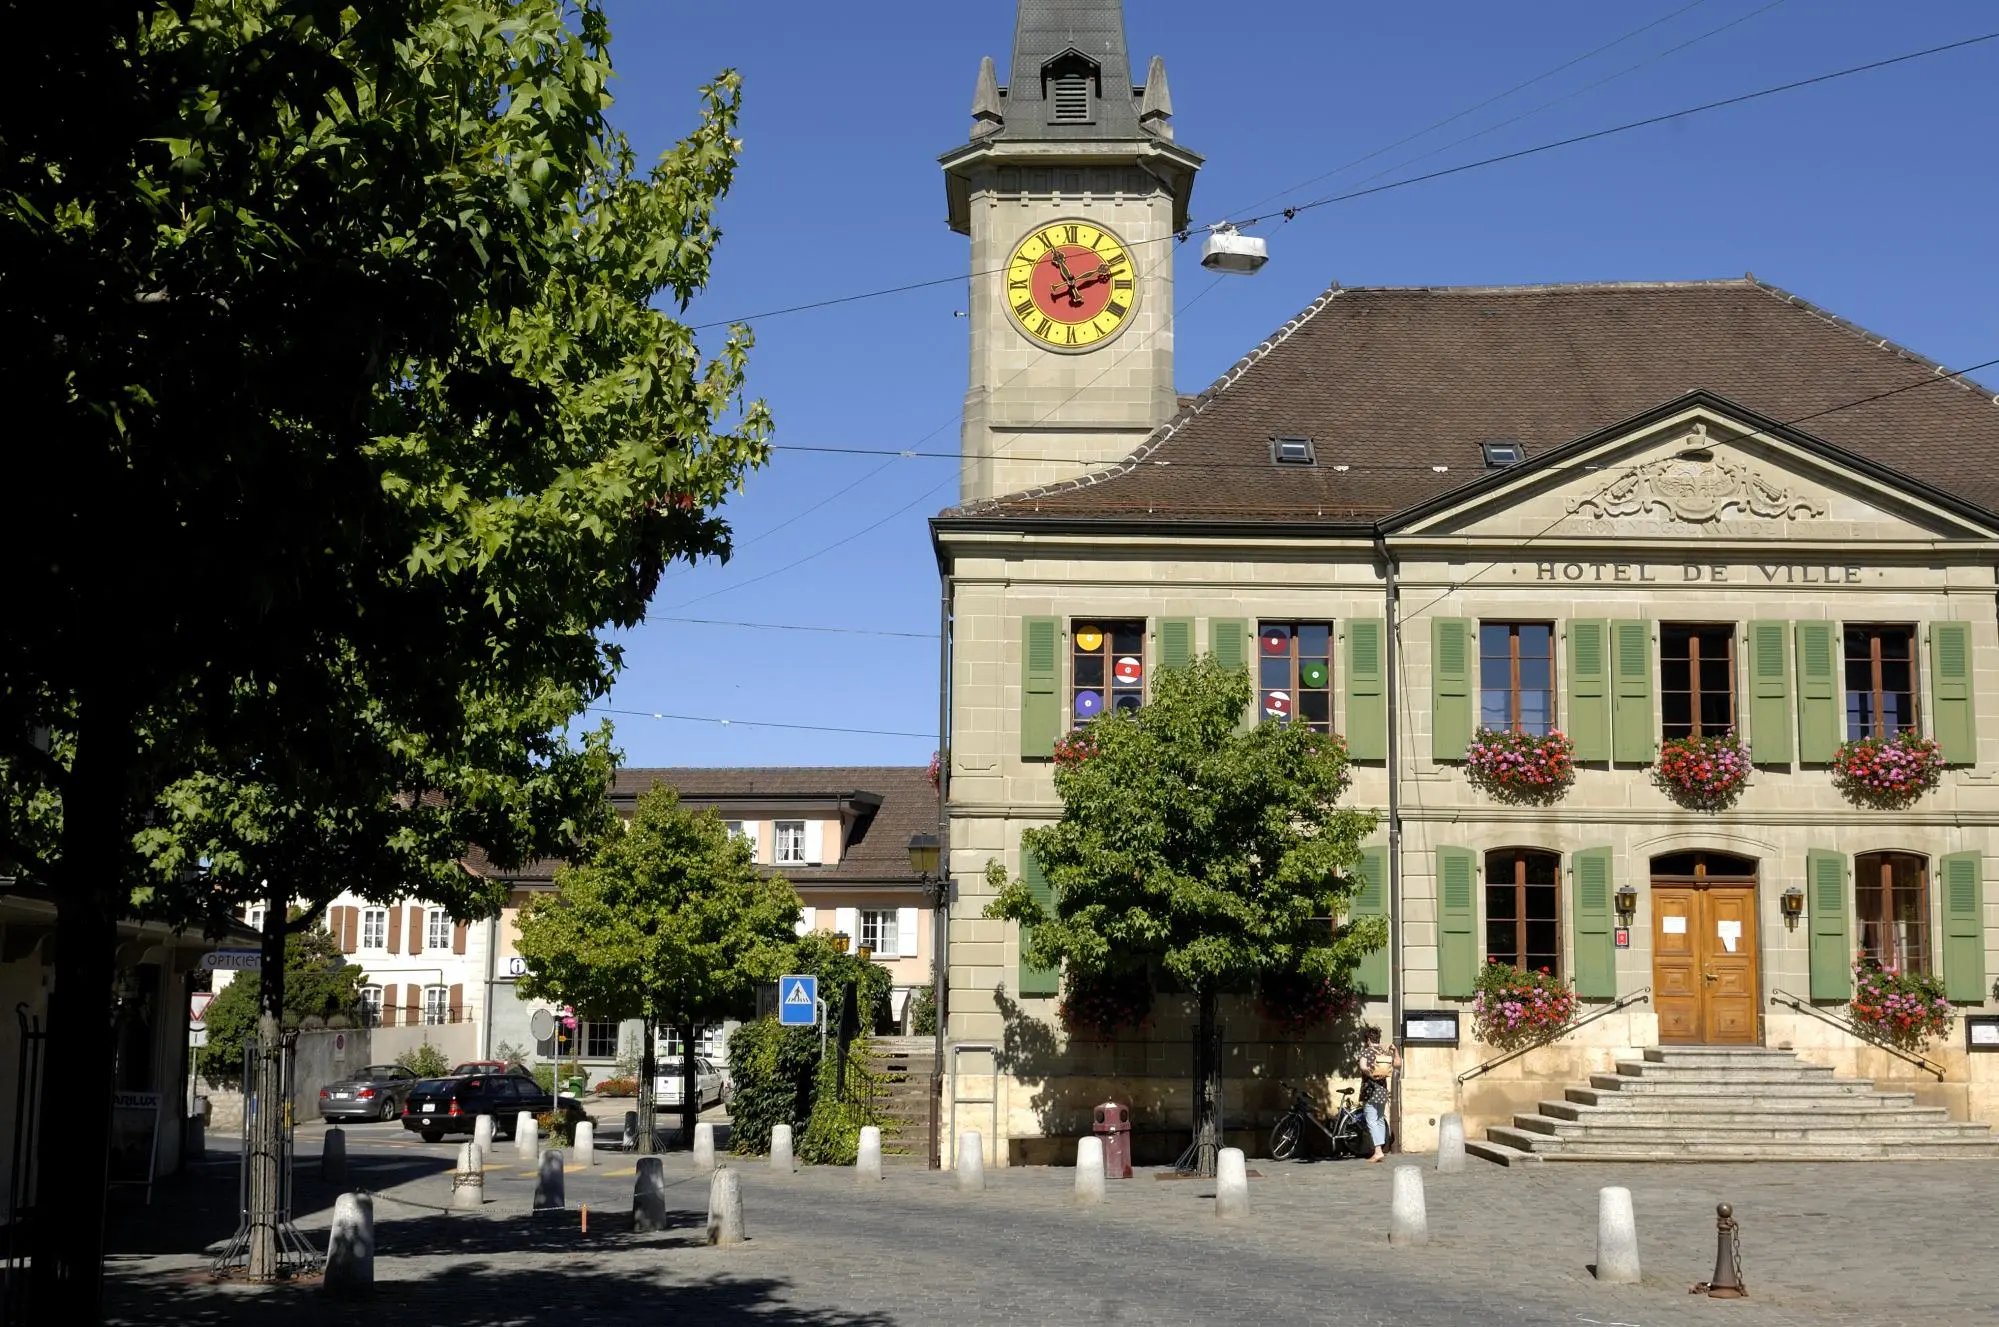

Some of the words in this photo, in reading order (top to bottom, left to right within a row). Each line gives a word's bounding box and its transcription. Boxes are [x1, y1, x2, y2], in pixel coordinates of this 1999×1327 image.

[1063, 226, 1078, 243] XII
[1091, 233, 1104, 249] I
[1536, 562, 1656, 581] HOTEL
[1683, 563, 1728, 582] DE
[1757, 564, 1862, 583] VILLE
